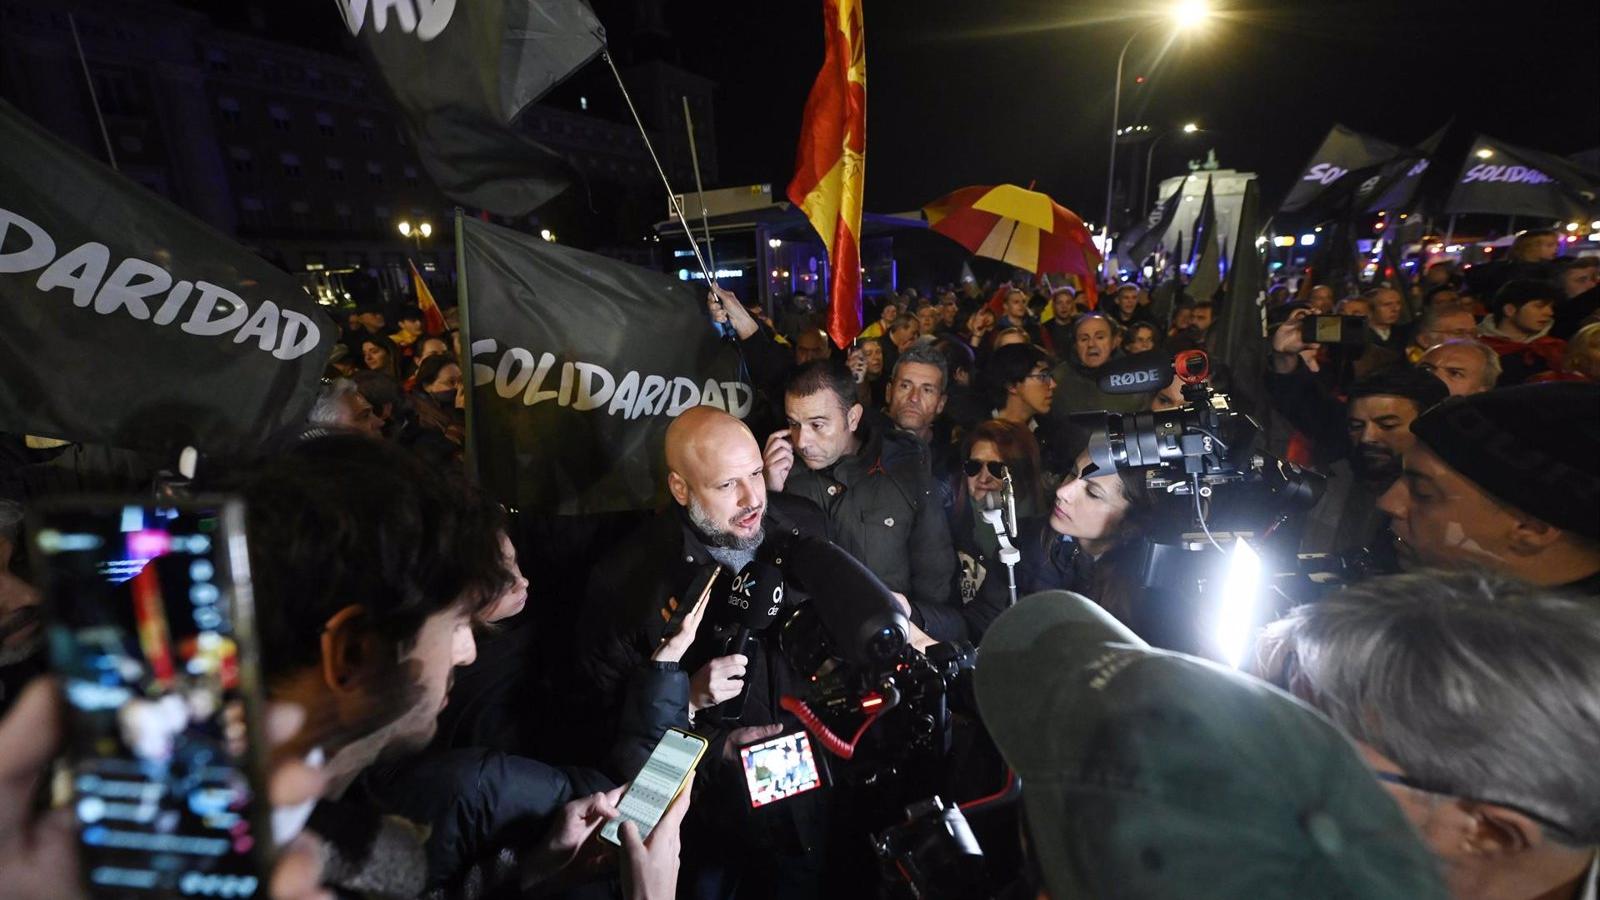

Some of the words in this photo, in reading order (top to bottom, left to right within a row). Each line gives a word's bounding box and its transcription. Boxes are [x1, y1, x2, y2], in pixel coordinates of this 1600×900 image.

[0, 207, 321, 361] DARIDAD
[471, 339, 753, 419] SOLIDARIDAD
[1109, 368, 1160, 387] RØDE
